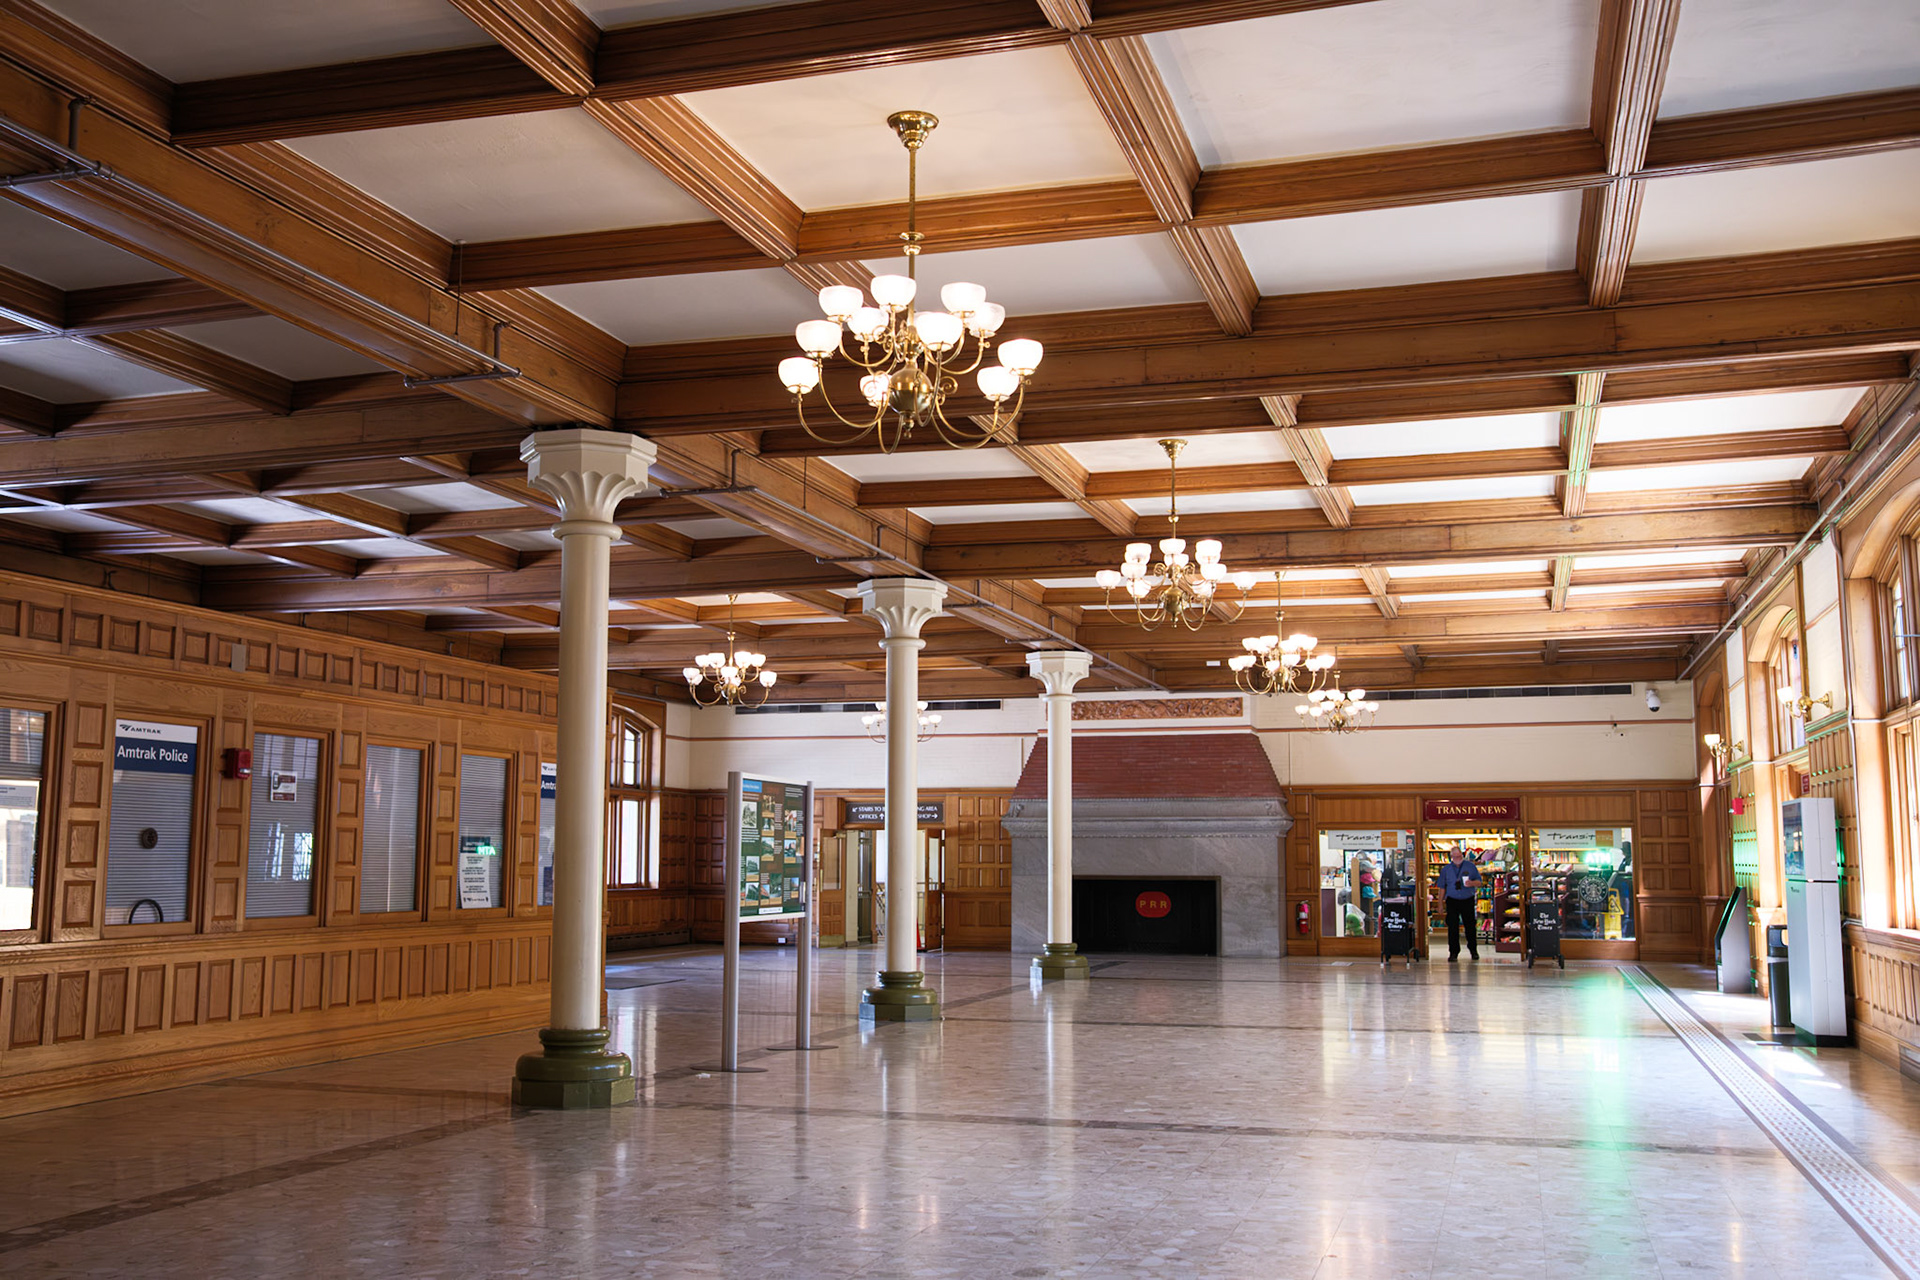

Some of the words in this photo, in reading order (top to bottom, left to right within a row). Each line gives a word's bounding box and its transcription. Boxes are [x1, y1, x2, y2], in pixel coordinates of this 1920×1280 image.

[117, 745, 157, 760] Amtrak
[160, 748, 188, 762] Police
[1436, 806, 1478, 815] TRANSIT
[1480, 806, 1507, 814] NEWS
[1585, 852, 1610, 864] ATM
